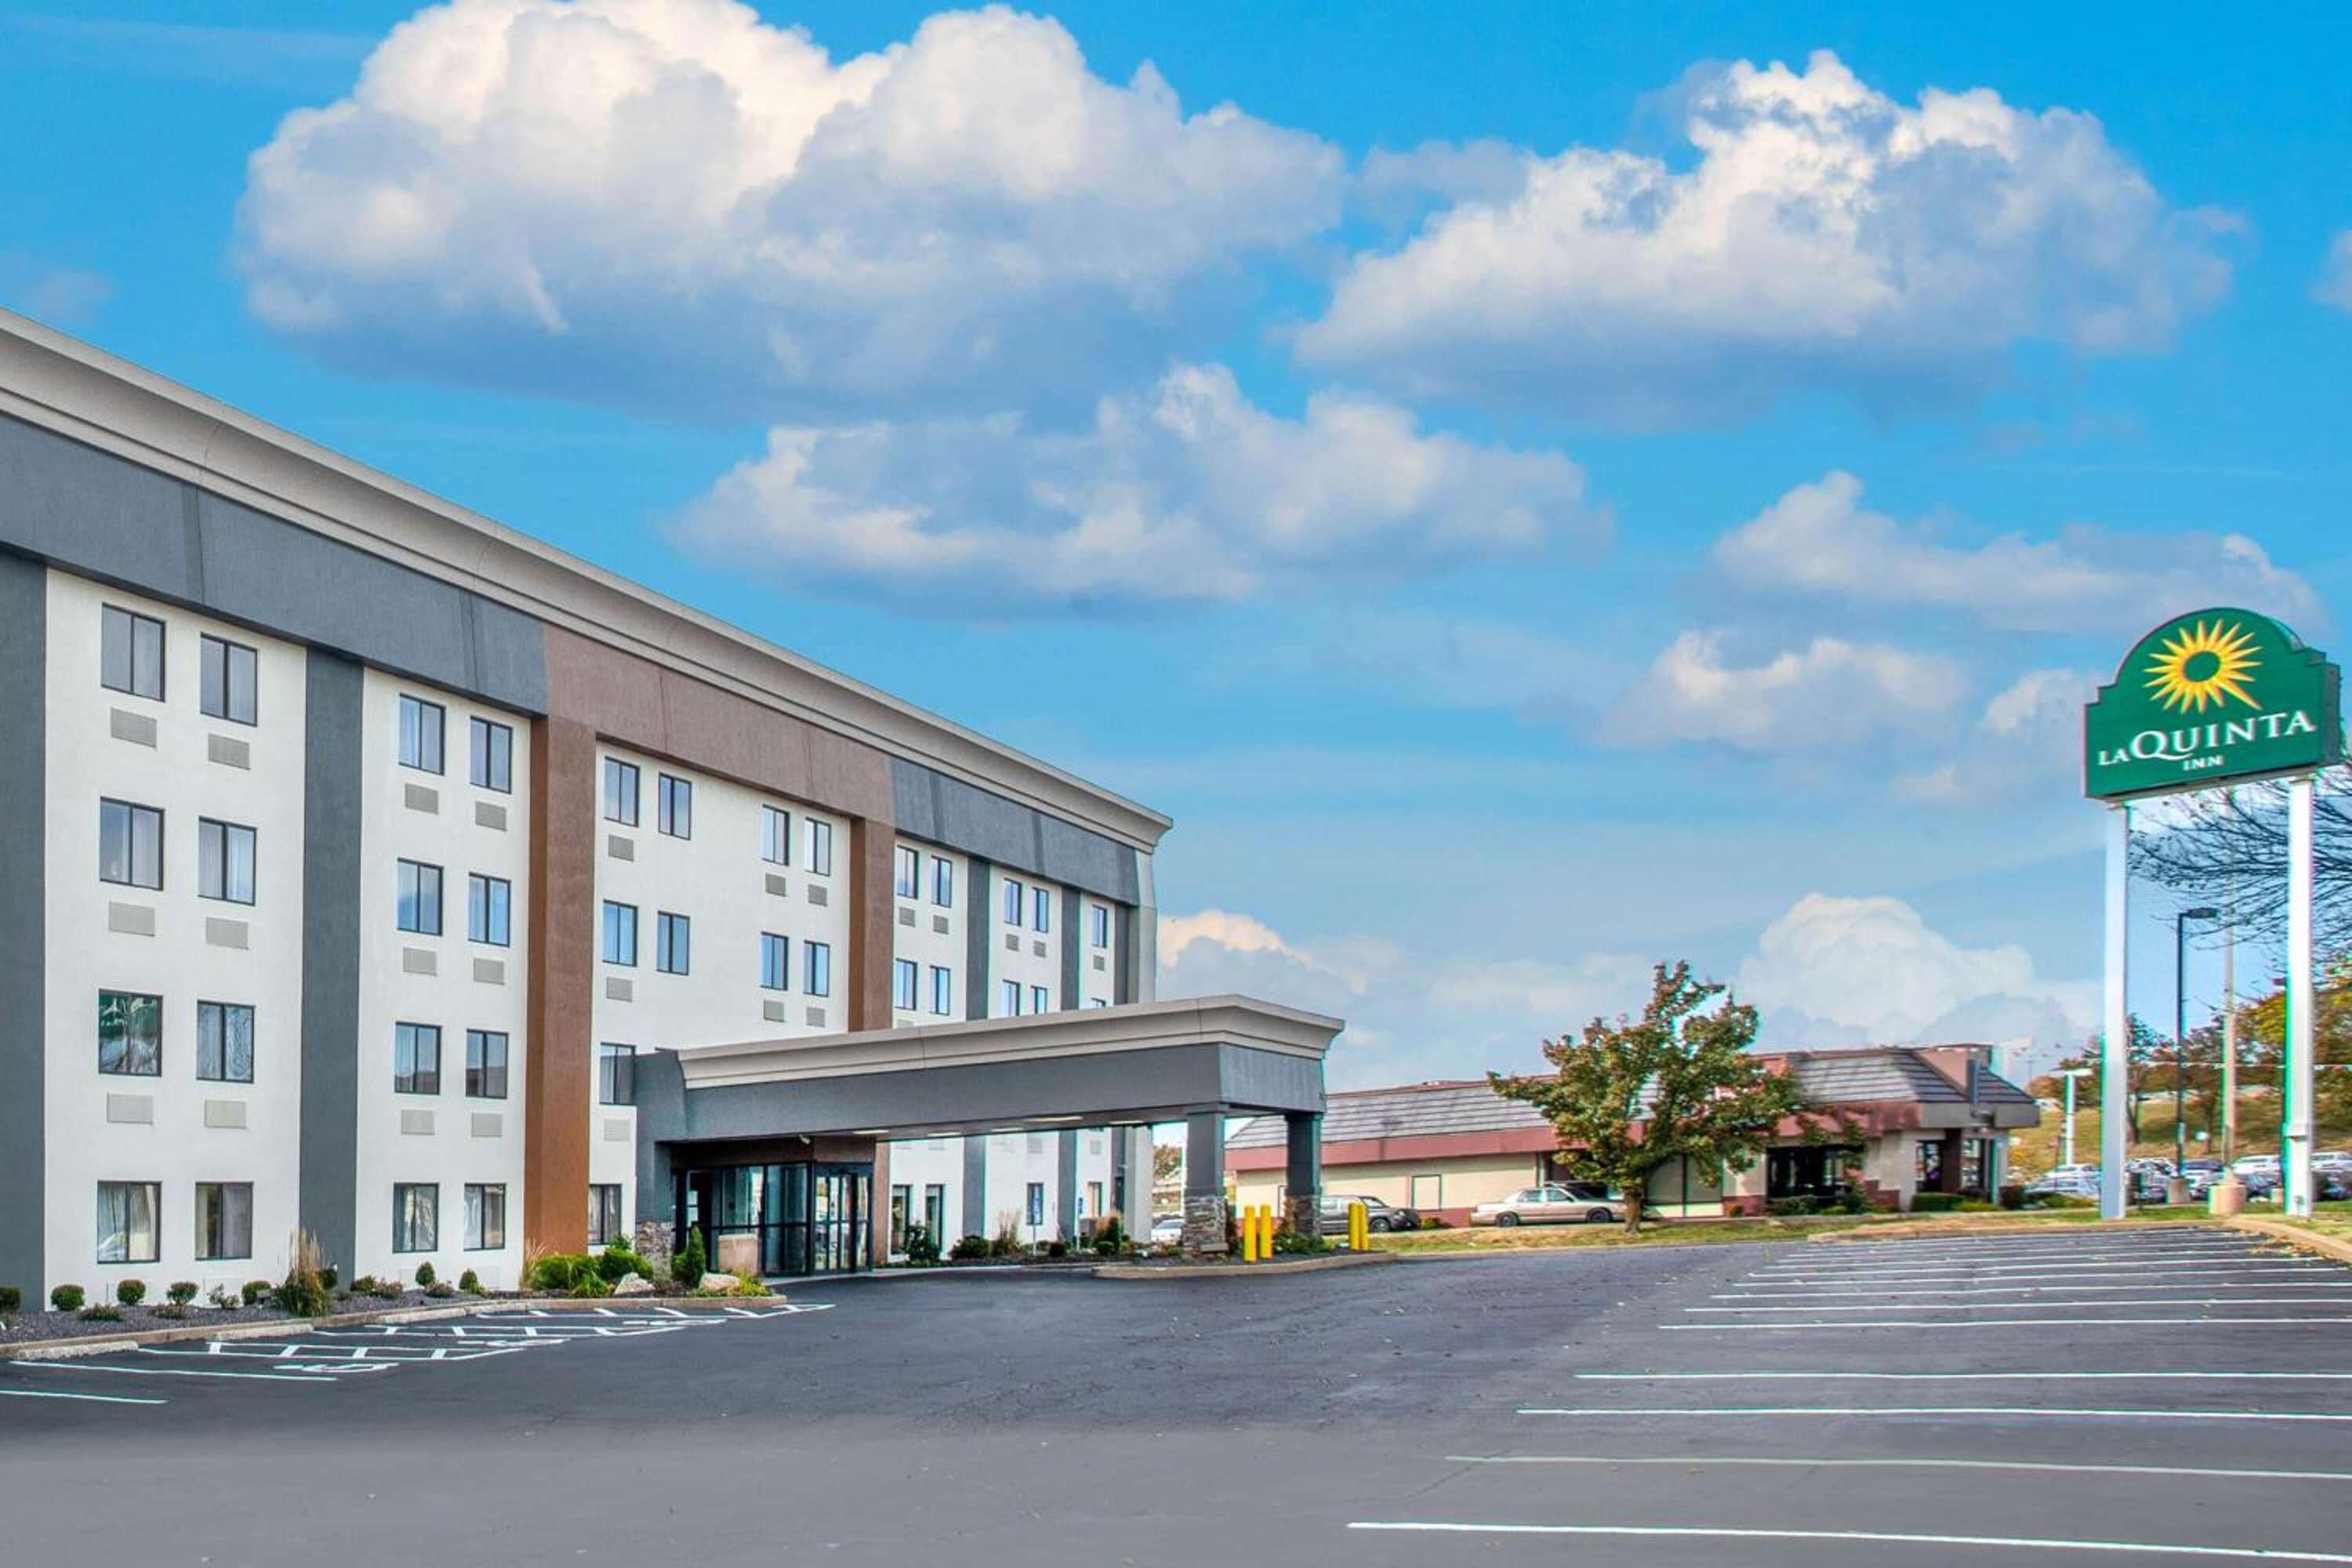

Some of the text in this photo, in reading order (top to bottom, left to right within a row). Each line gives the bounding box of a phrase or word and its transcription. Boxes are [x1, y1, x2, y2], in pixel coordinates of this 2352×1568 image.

[2098, 710, 2317, 766] LA QUINTA
[2182, 755, 2224, 771] INN
